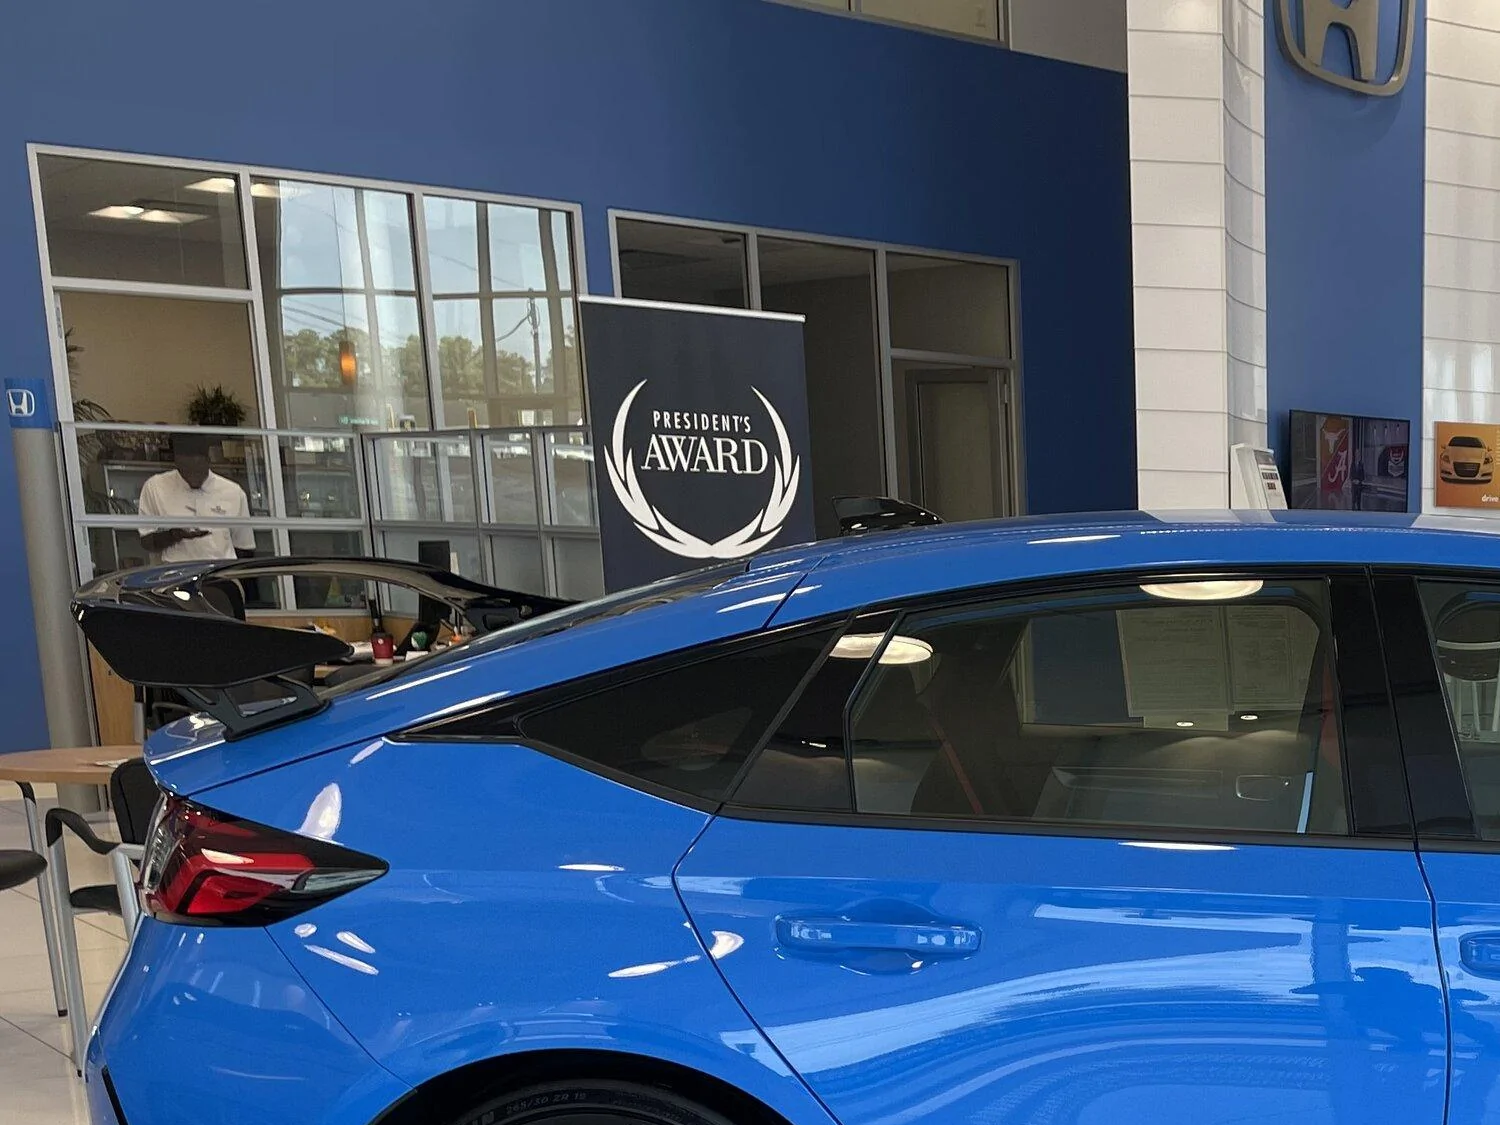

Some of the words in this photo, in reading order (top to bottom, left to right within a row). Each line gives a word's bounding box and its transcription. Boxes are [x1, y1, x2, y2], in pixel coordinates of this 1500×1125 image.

[652, 410, 751, 433] PRESIDENT'S
[640, 433, 769, 475] AWARD
[1481, 493, 1499, 503] drive
